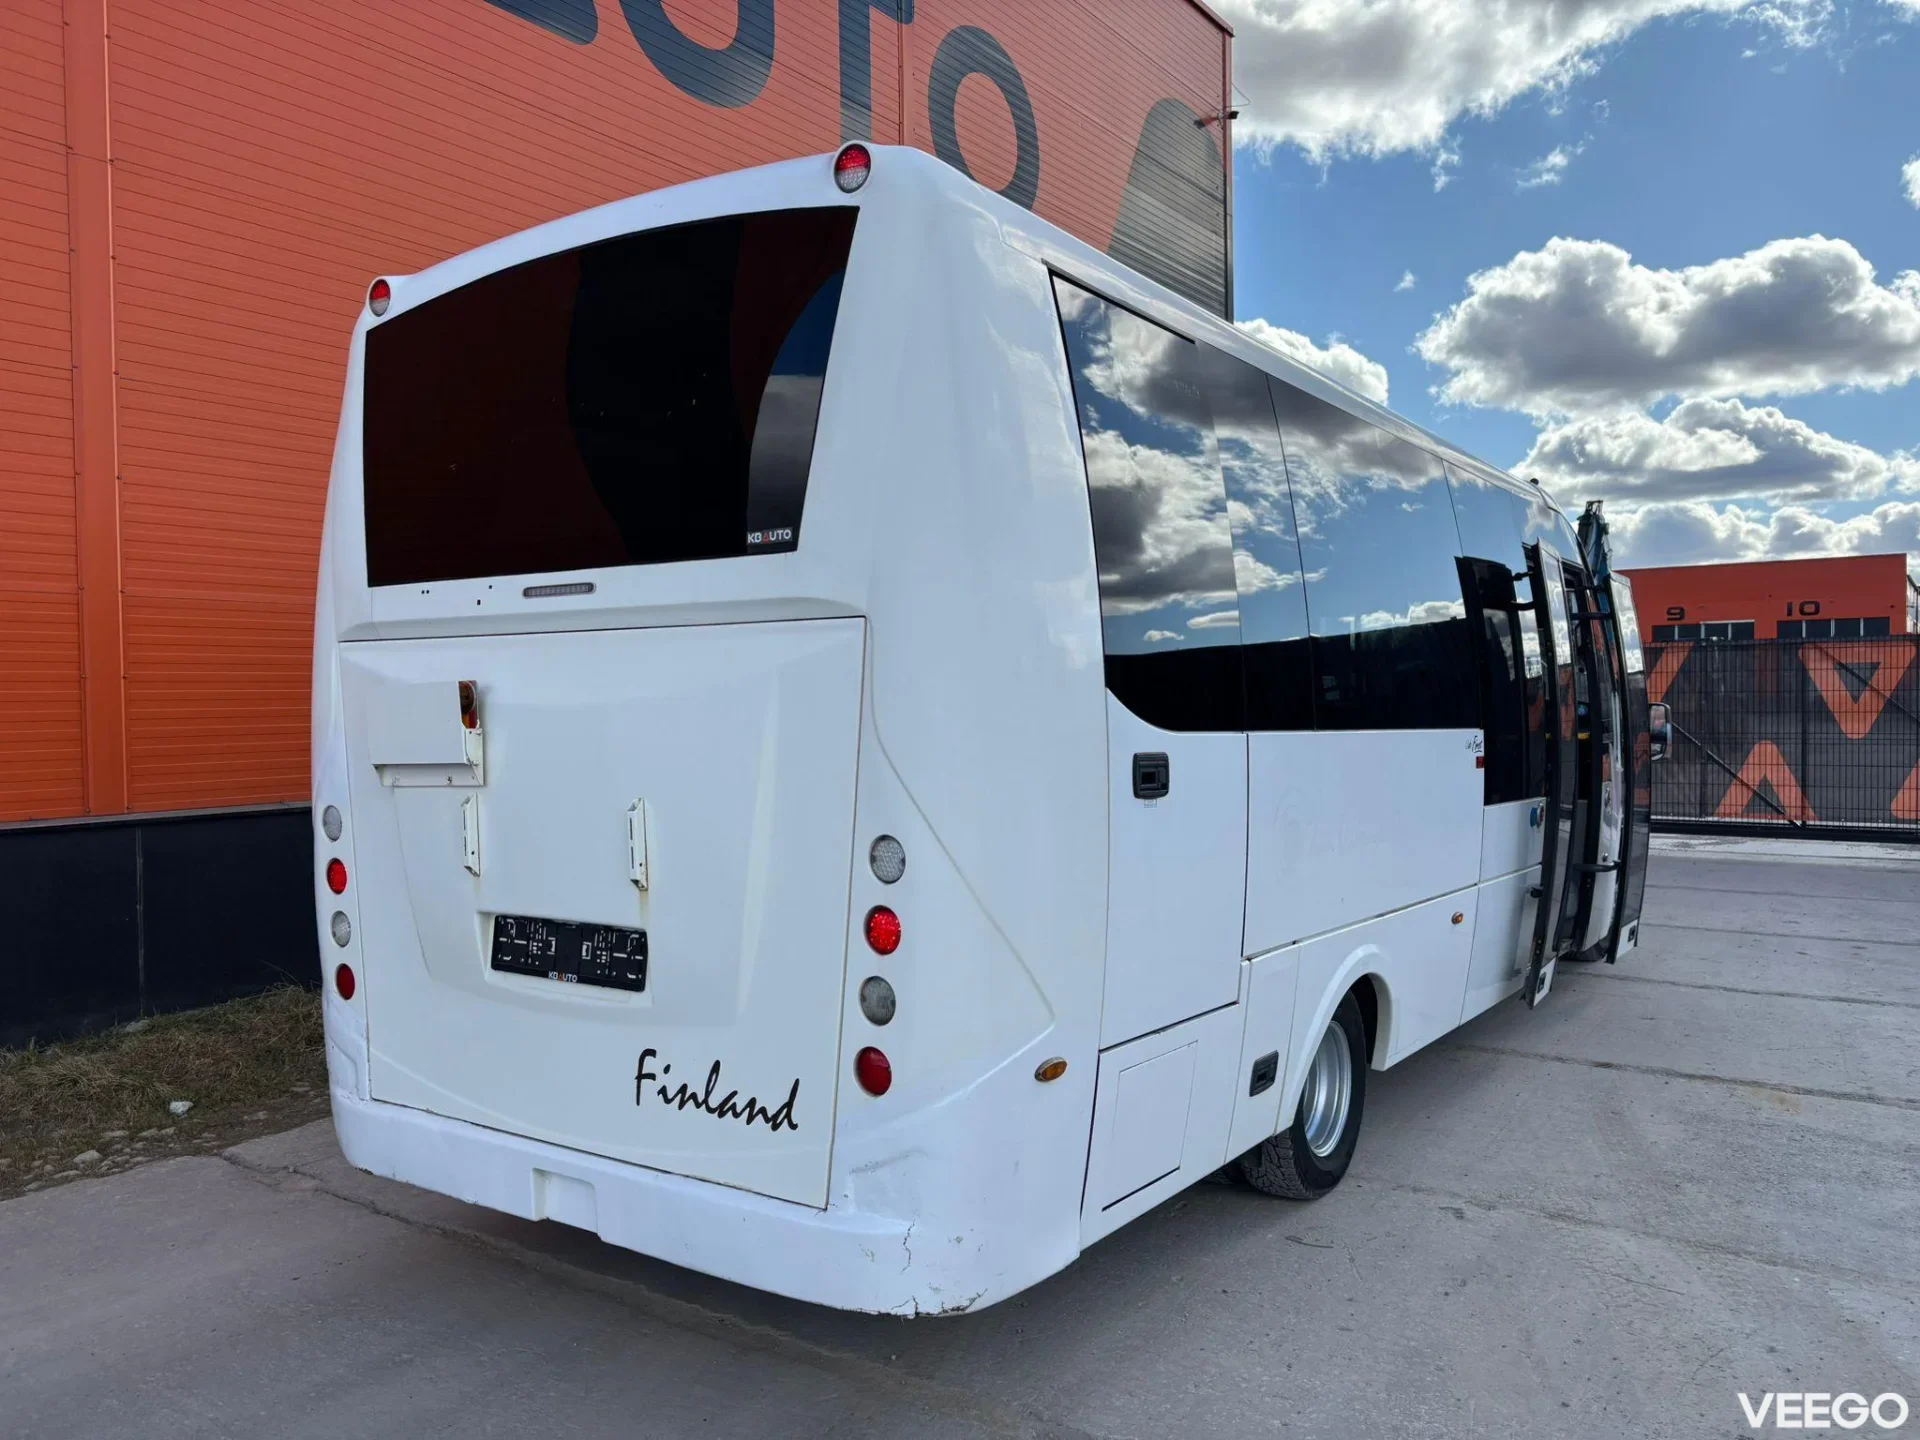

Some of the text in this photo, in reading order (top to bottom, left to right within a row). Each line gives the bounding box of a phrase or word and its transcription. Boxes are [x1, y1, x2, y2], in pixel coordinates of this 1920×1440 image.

[1666, 606, 1686, 622] 9
[1786, 600, 1821, 617] 10
[634, 1048, 800, 1132] Finland
